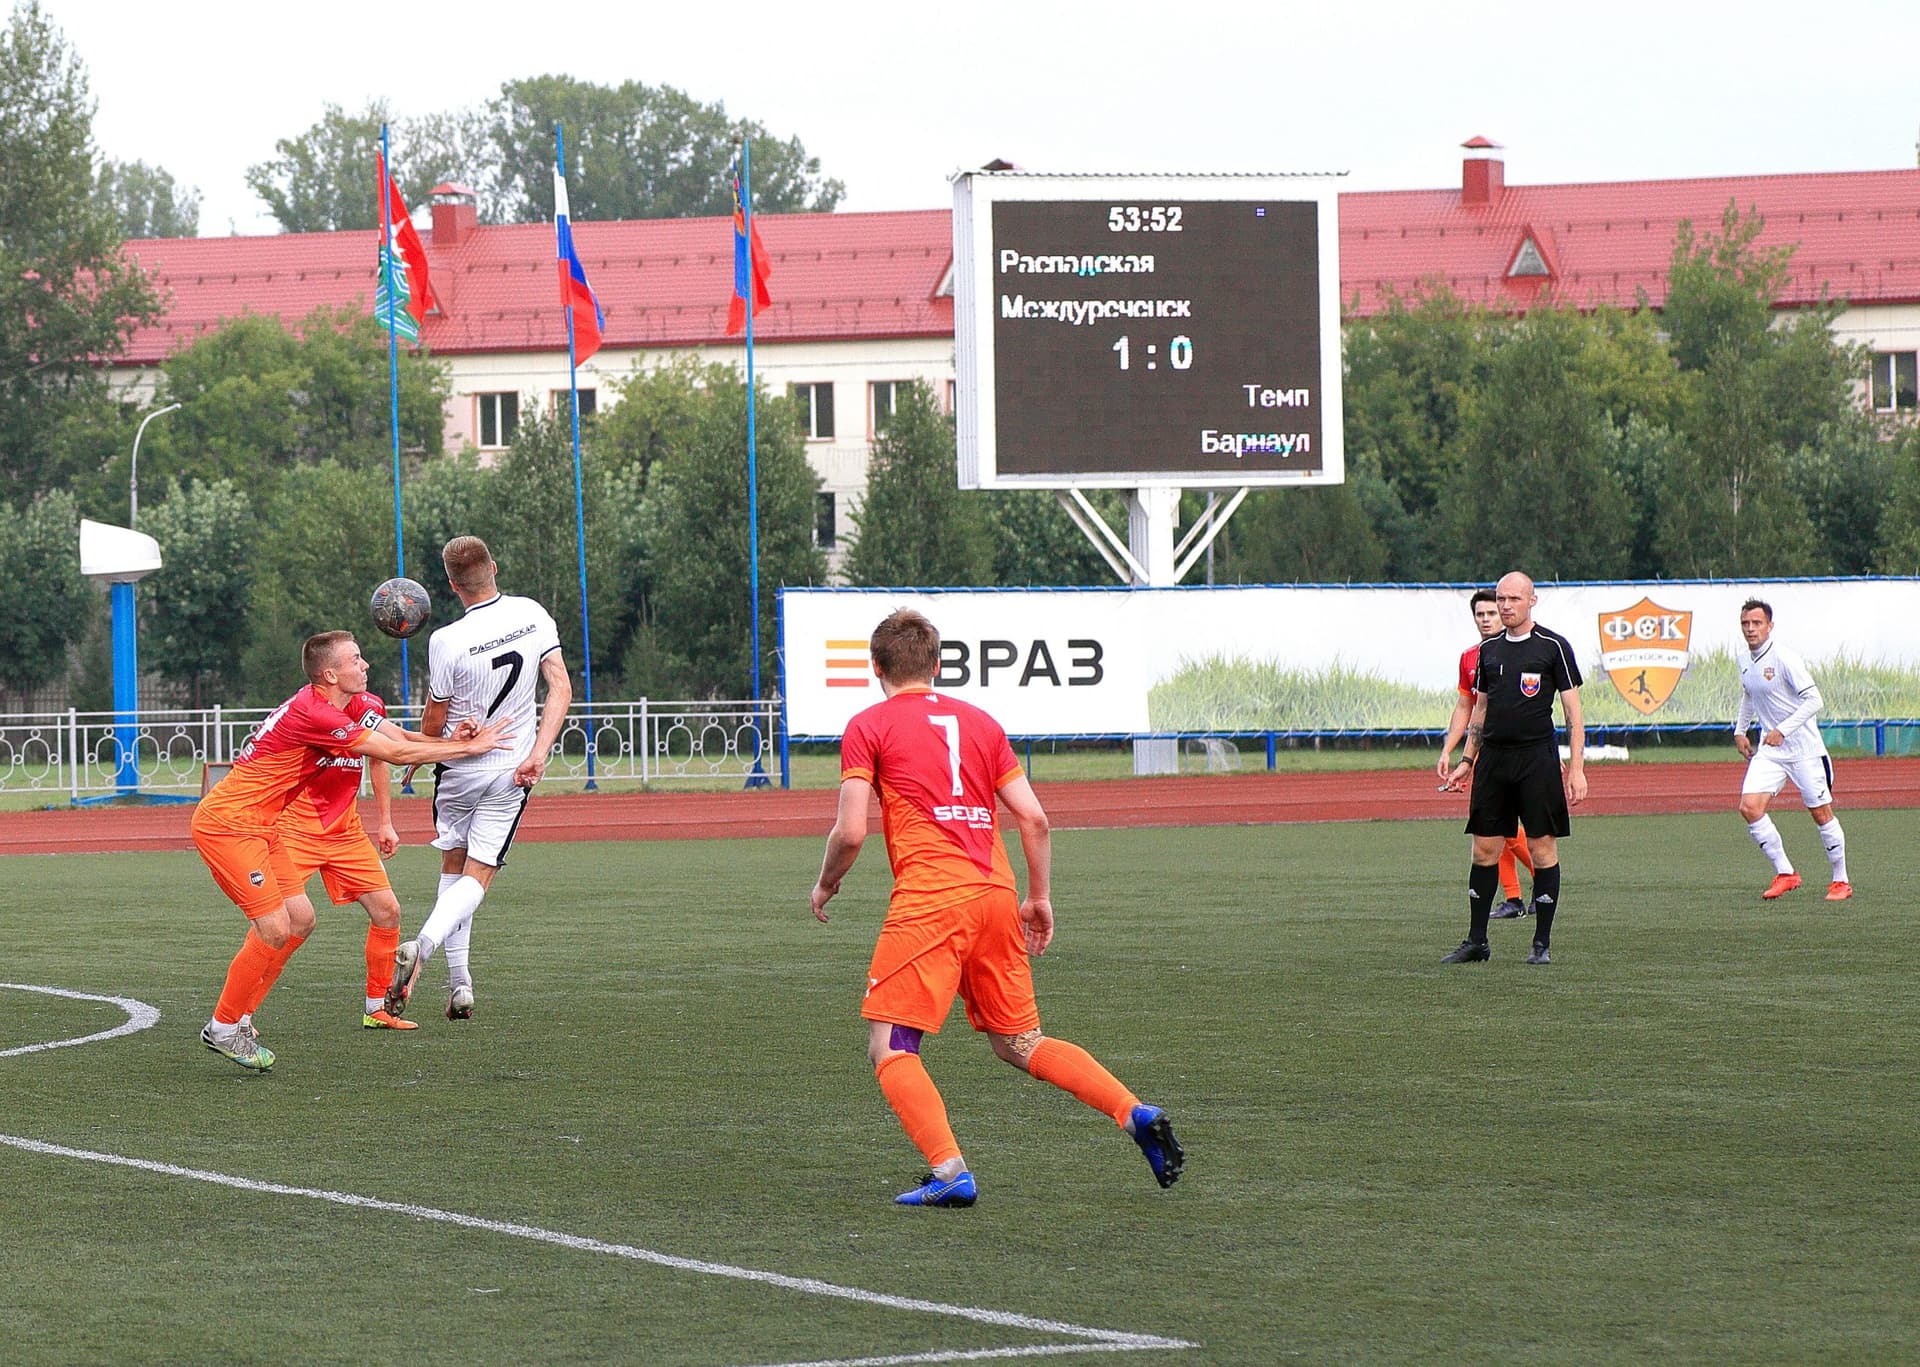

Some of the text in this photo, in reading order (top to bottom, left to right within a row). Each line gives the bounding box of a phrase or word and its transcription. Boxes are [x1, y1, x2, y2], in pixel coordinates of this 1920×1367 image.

[1108, 206, 1183, 231] 53:52
[1242, 384, 1310, 408] Темп
[1201, 429, 1311, 458] Барнаул
[1603, 614, 1685, 640] ФСК
[486, 650, 524, 719] 7
